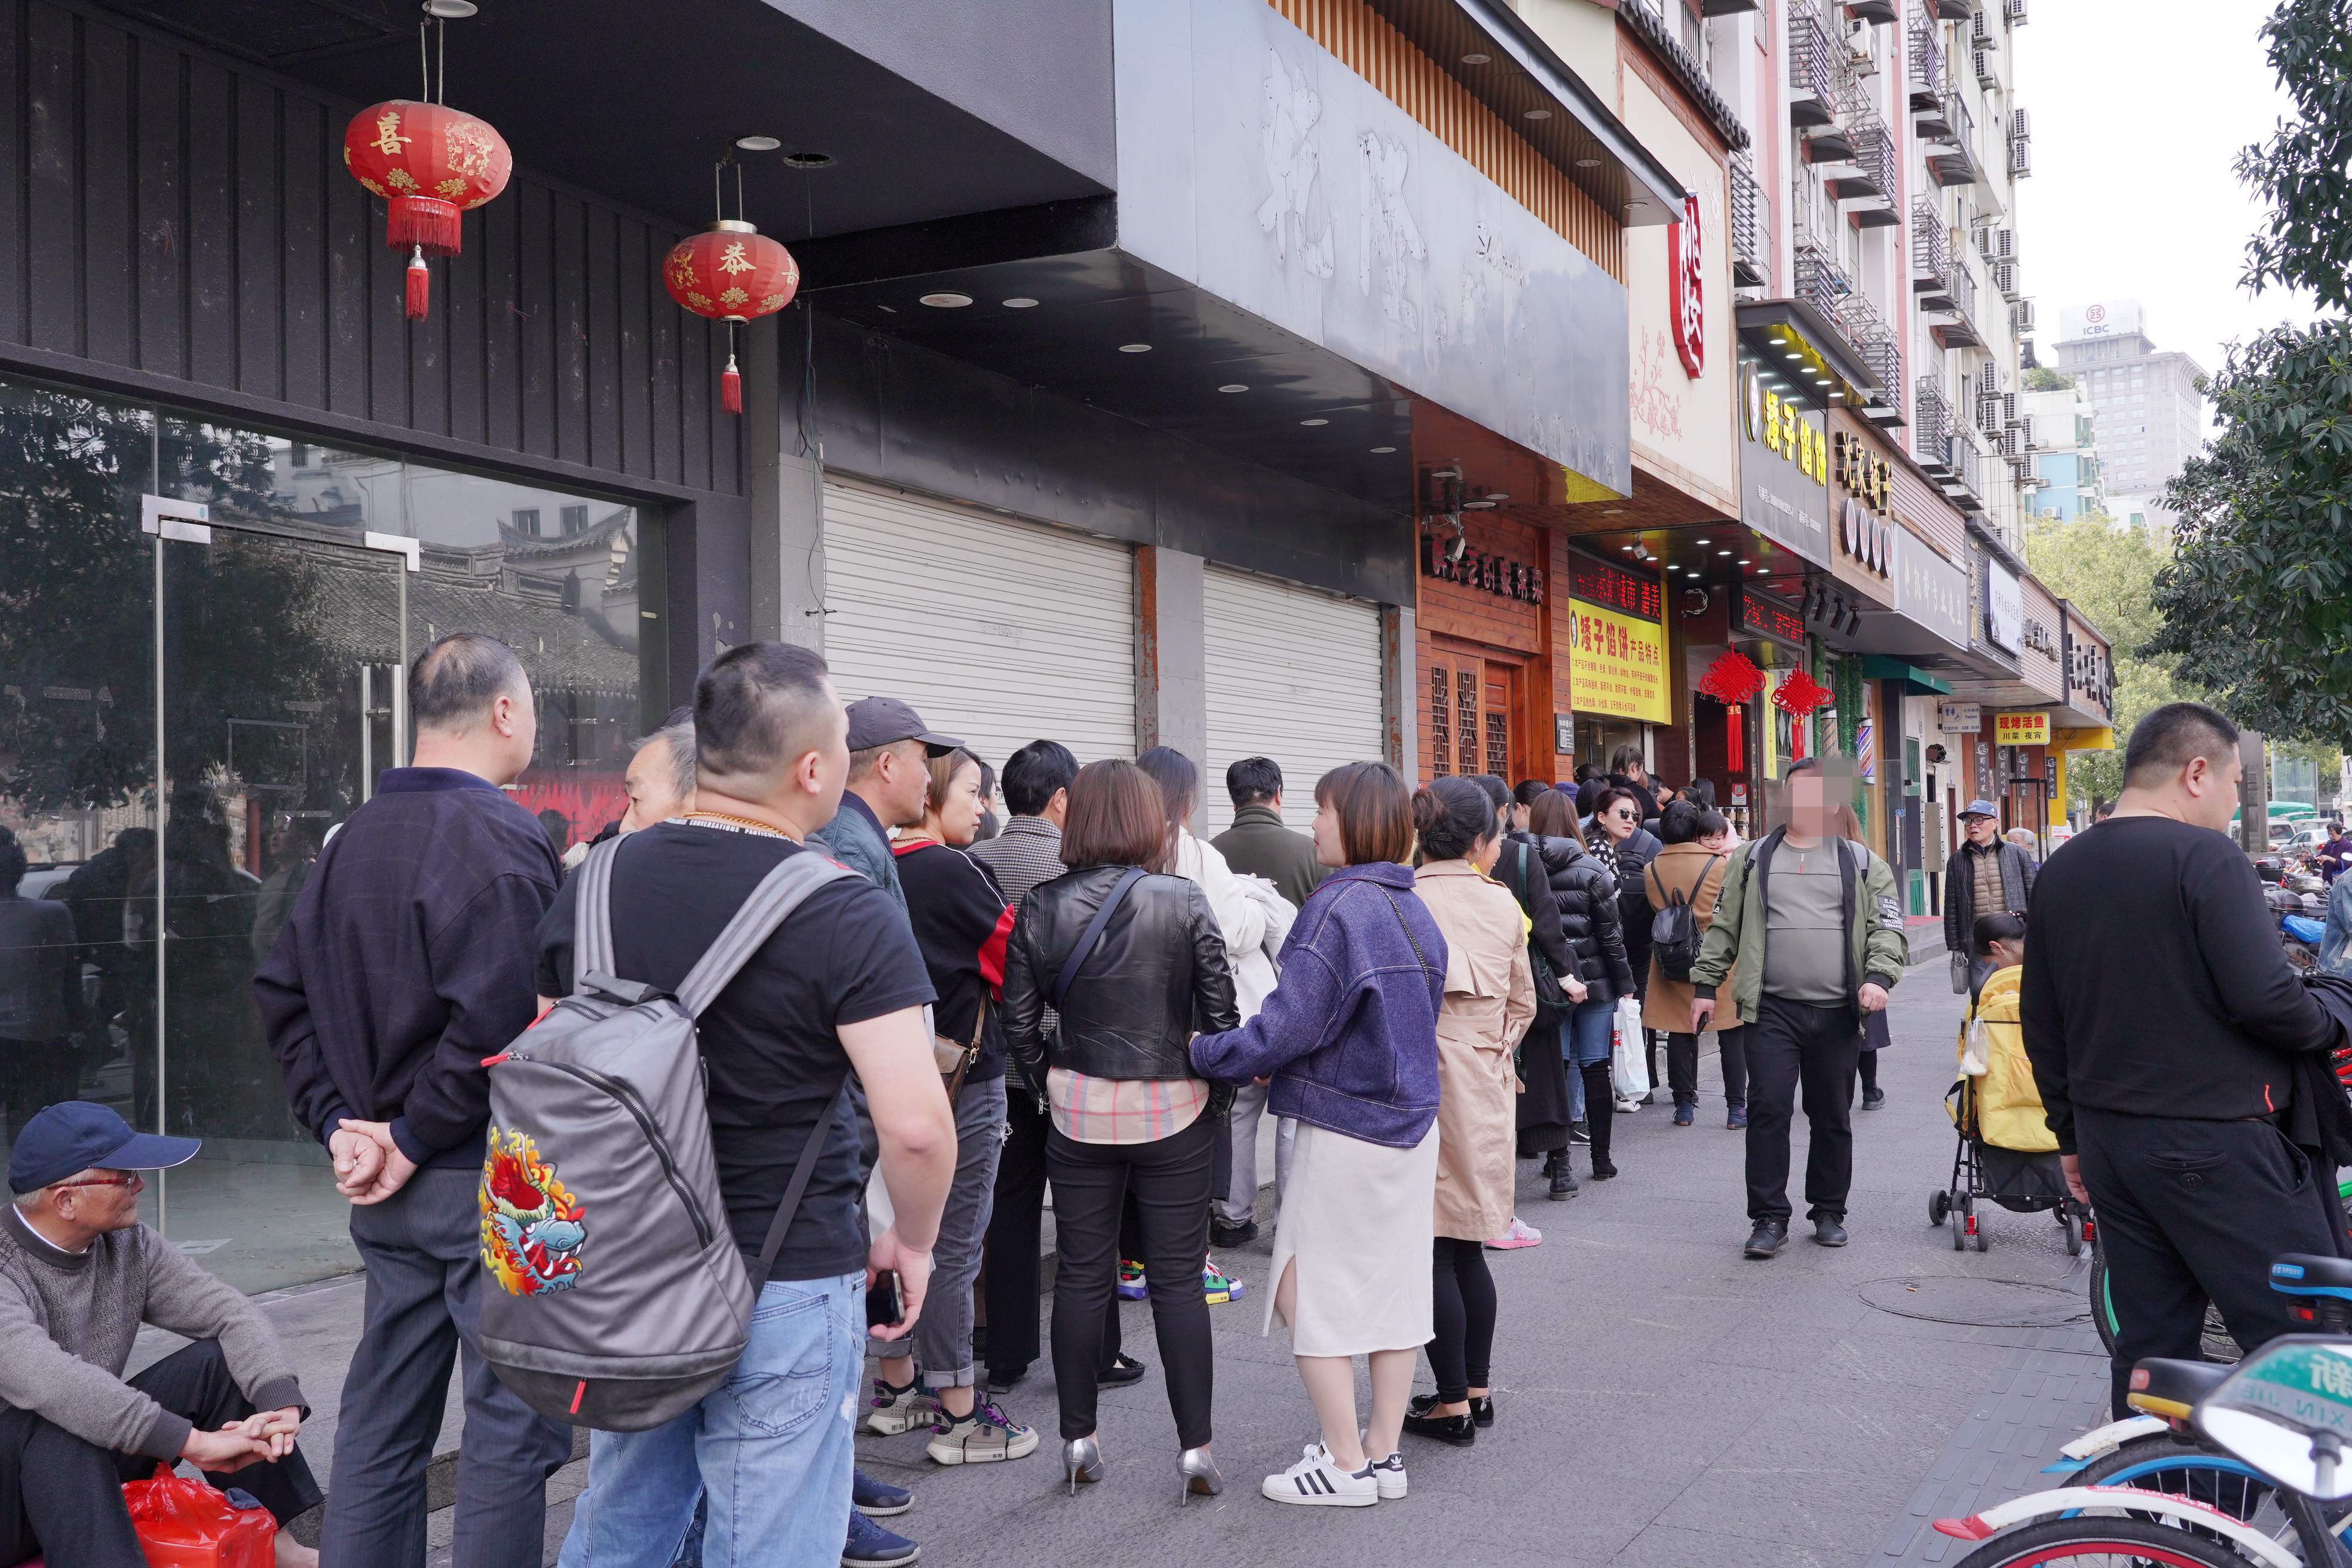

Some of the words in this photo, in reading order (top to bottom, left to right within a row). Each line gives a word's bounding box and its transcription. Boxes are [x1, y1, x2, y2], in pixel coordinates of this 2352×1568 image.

[370, 112, 412, 155] 喜
[717, 241, 757, 276] 恭
[2083, 324, 2109, 335] ICBC
[1762, 388, 1827, 487] 矮子馅饼
[1581, 614, 1628, 662] 矮子馅饼
[1630, 638, 1659, 666] 产品特点
[1999, 716, 2044, 729] 现烤活鱼
[2003, 732, 2019, 740] 川菜
[2025, 731, 2042, 740] 夜宵
